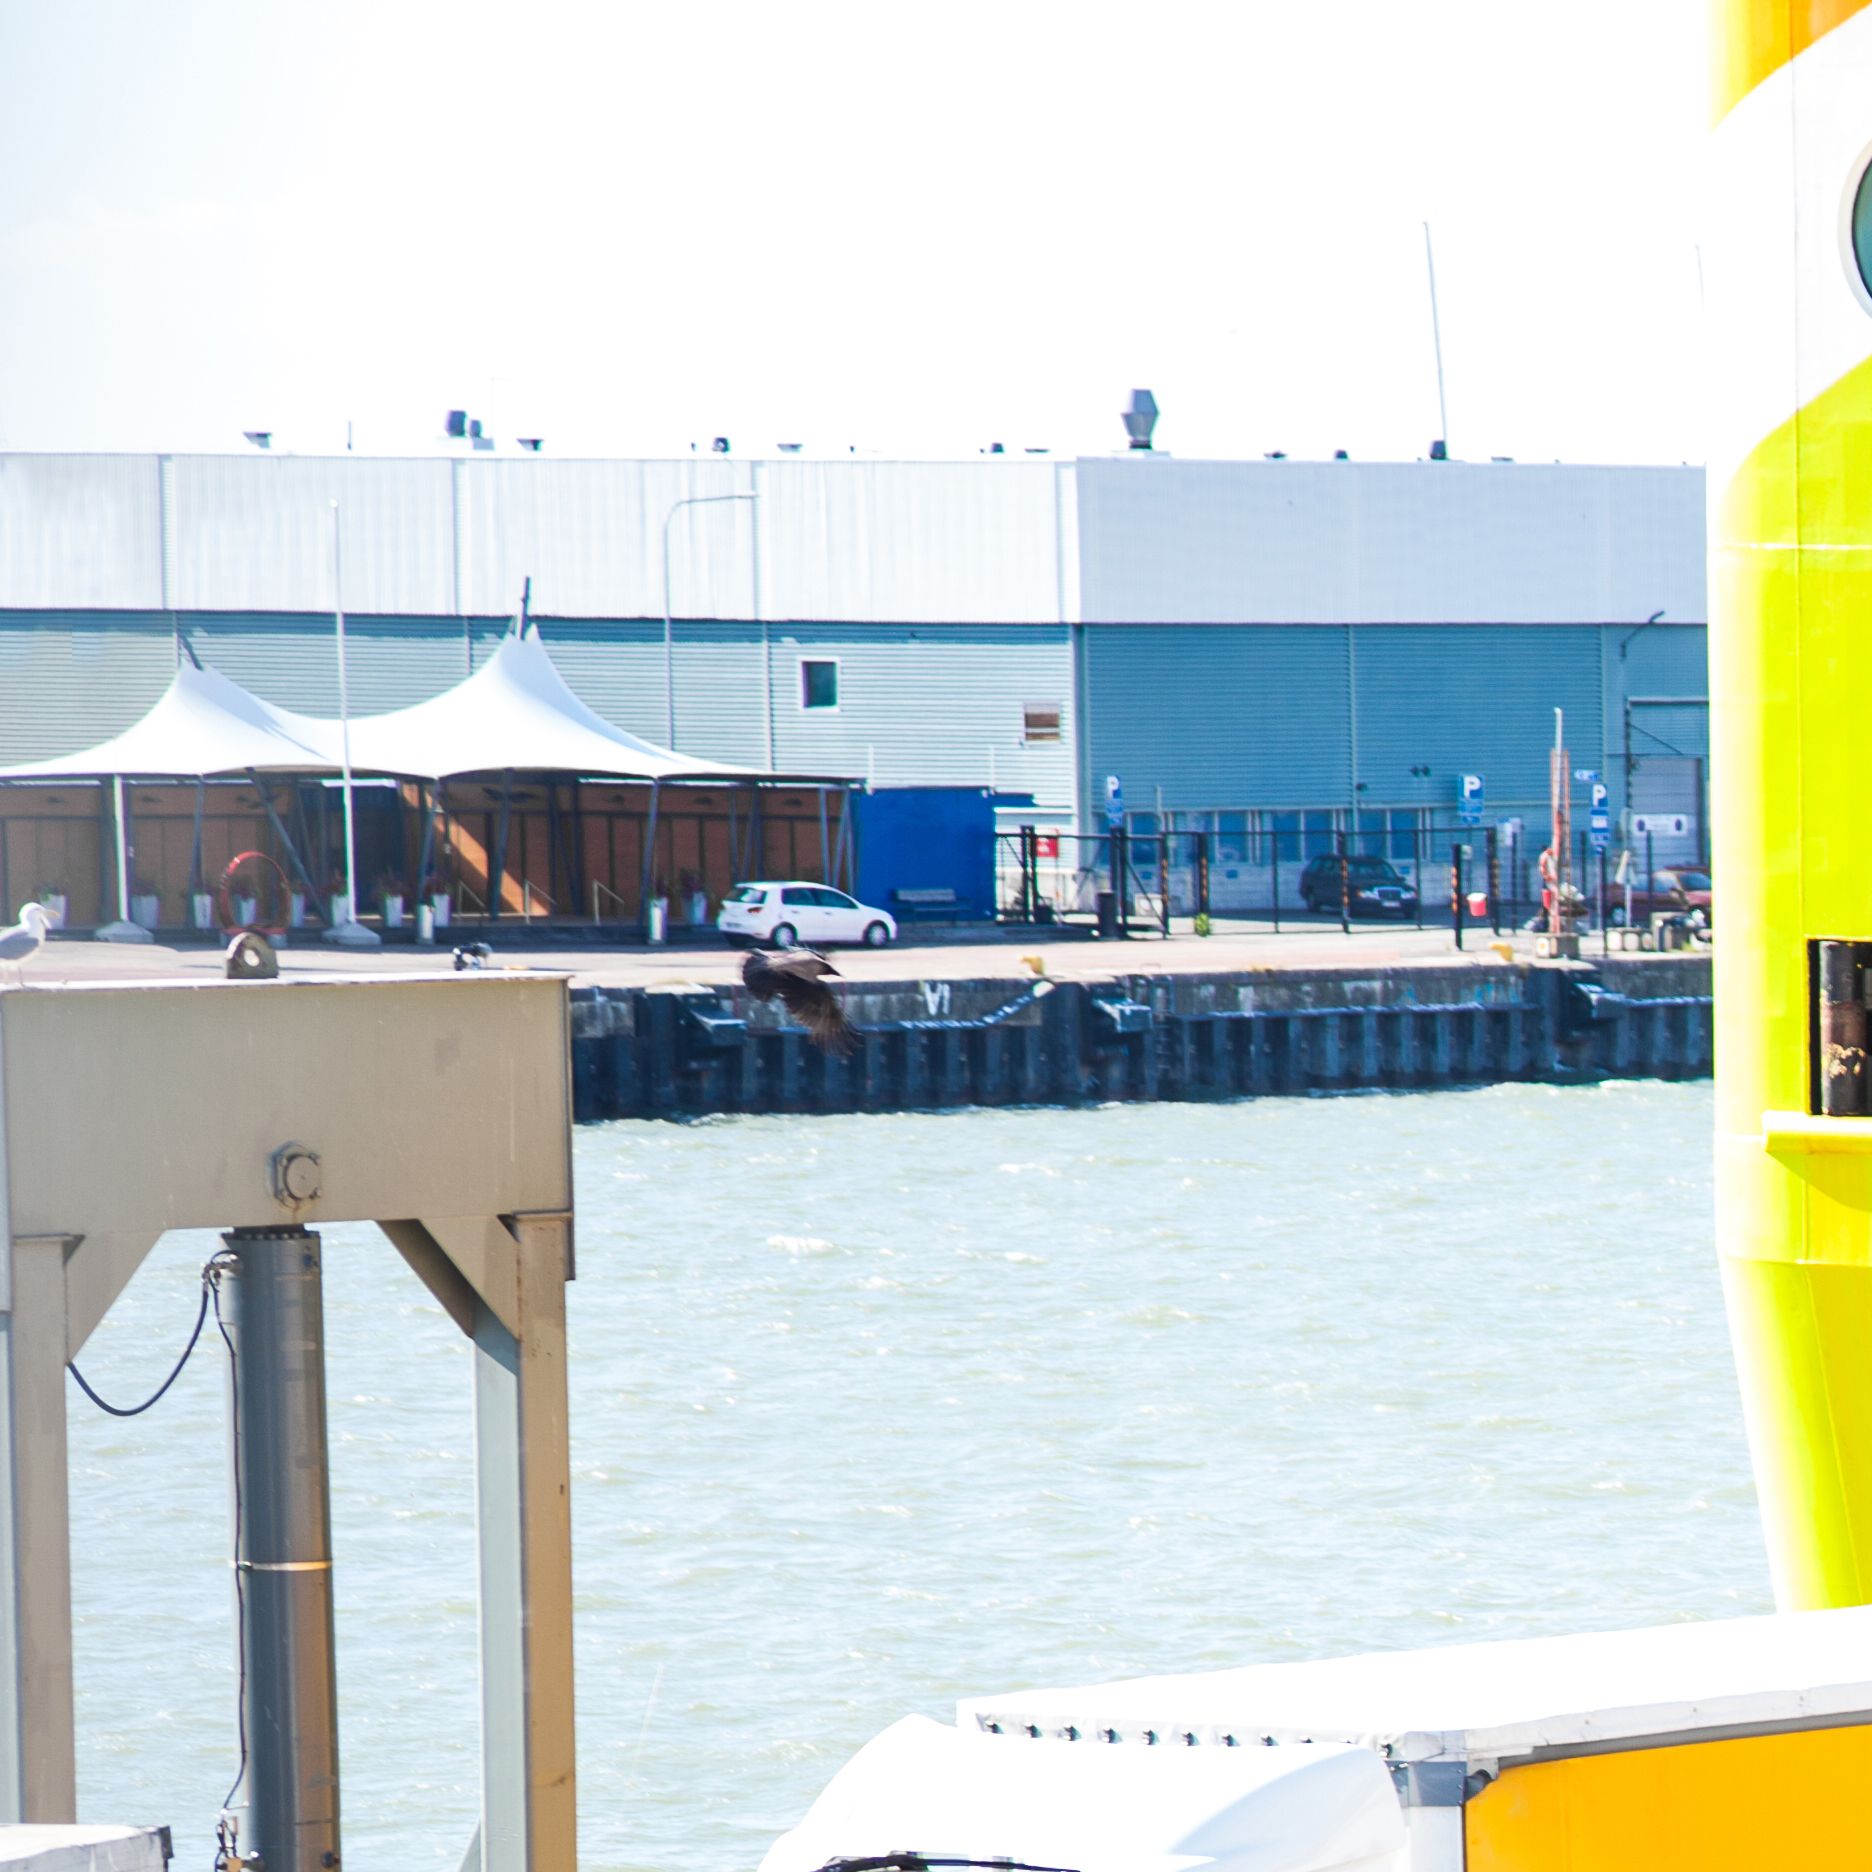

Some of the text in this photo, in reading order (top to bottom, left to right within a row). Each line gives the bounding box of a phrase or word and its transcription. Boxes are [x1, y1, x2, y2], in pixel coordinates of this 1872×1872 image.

[1106, 775, 1120, 799] P
[1463, 775, 1481, 799] P
[1593, 784, 1607, 807] P
